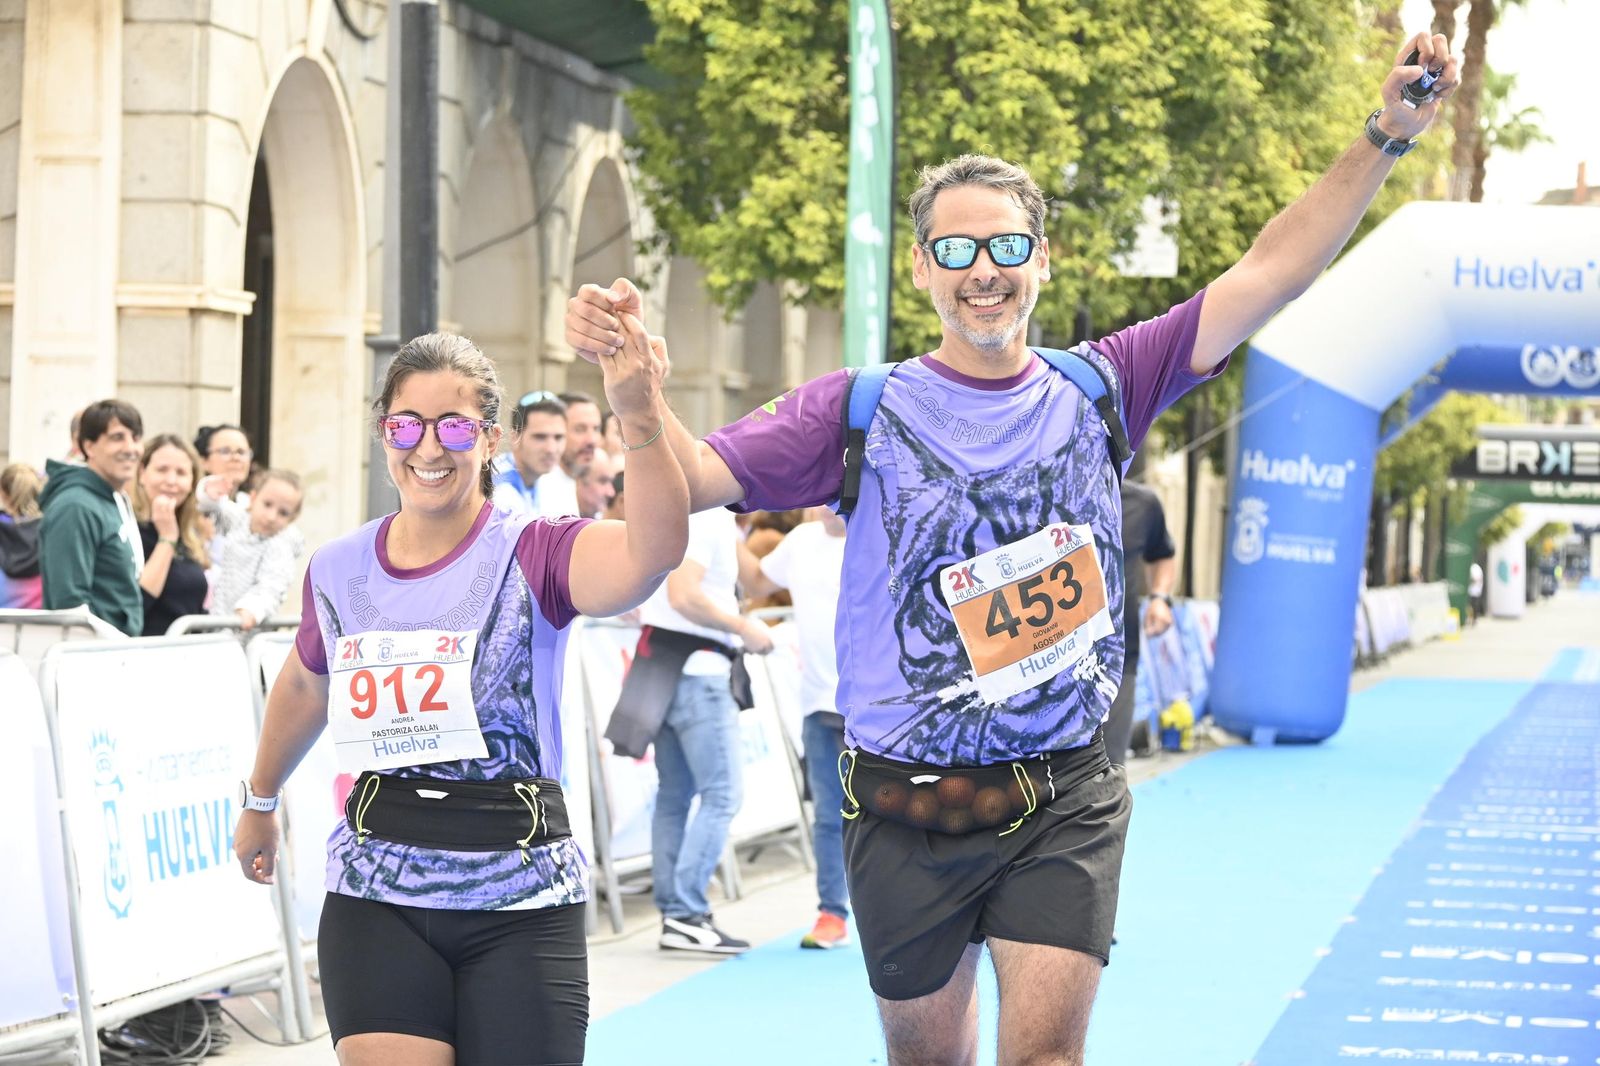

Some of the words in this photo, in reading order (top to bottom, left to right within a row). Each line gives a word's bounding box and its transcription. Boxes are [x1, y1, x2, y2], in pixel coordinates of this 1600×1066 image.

[1454, 256, 1583, 292] Huelva
[1056, 538, 1084, 557] HUELVA
[1018, 556, 1044, 571] HUELVA
[948, 562, 984, 591] 21K
[347, 575, 379, 628] LOS
[955, 583, 988, 602] HUELVA
[985, 561, 1083, 639] 453
[1032, 622, 1059, 639] GIOVANNI
[1033, 630, 1065, 651] AGOSTINI
[1019, 636, 1076, 678] Huelva
[349, 664, 449, 720] 912
[371, 727, 413, 738] PASTORIZA
[413, 724, 439, 733] GALAN
[372, 736, 438, 757] Huelva
